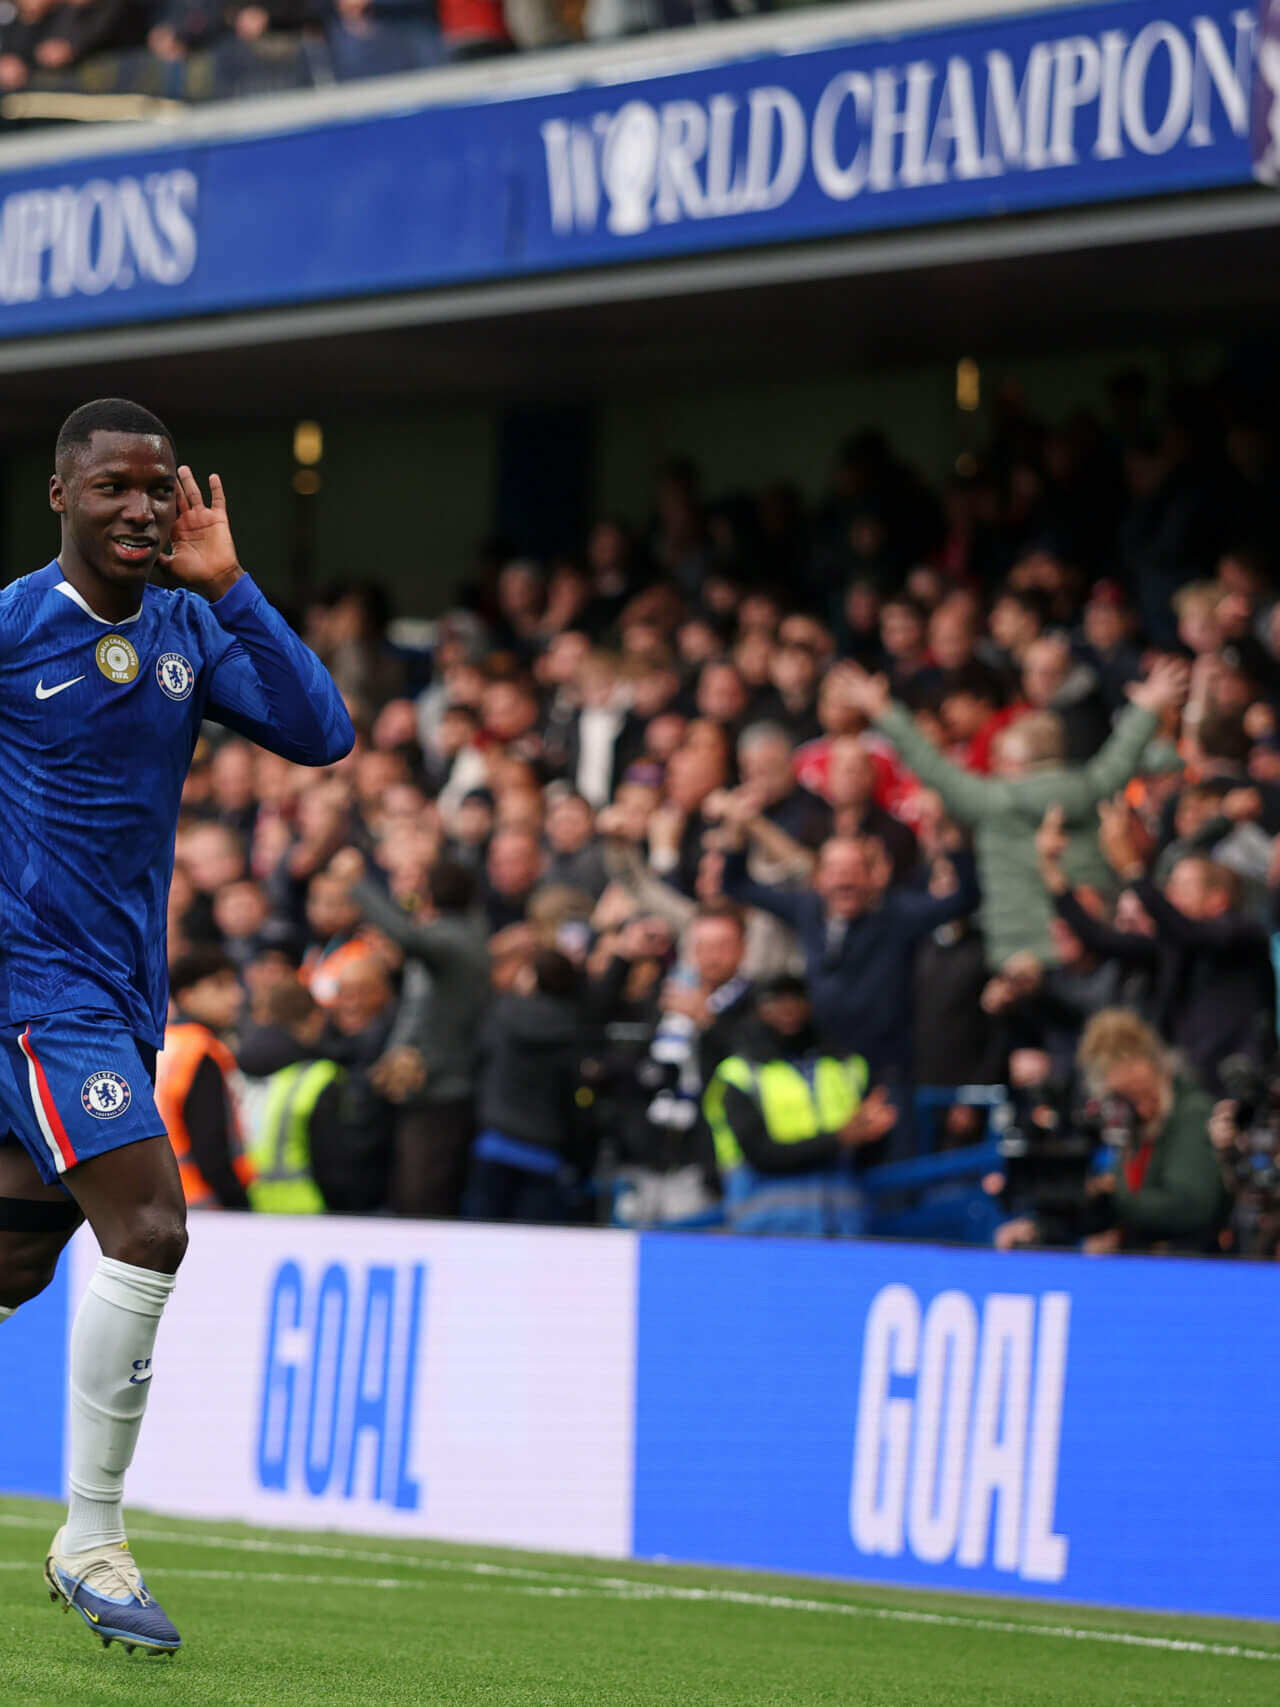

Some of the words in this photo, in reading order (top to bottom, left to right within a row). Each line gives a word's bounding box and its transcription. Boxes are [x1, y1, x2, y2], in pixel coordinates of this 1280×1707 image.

[85, 1073, 116, 1089] CHELSEA
[257, 1260, 426, 1511] GOAL
[849, 1283, 1071, 1583] GOAL
